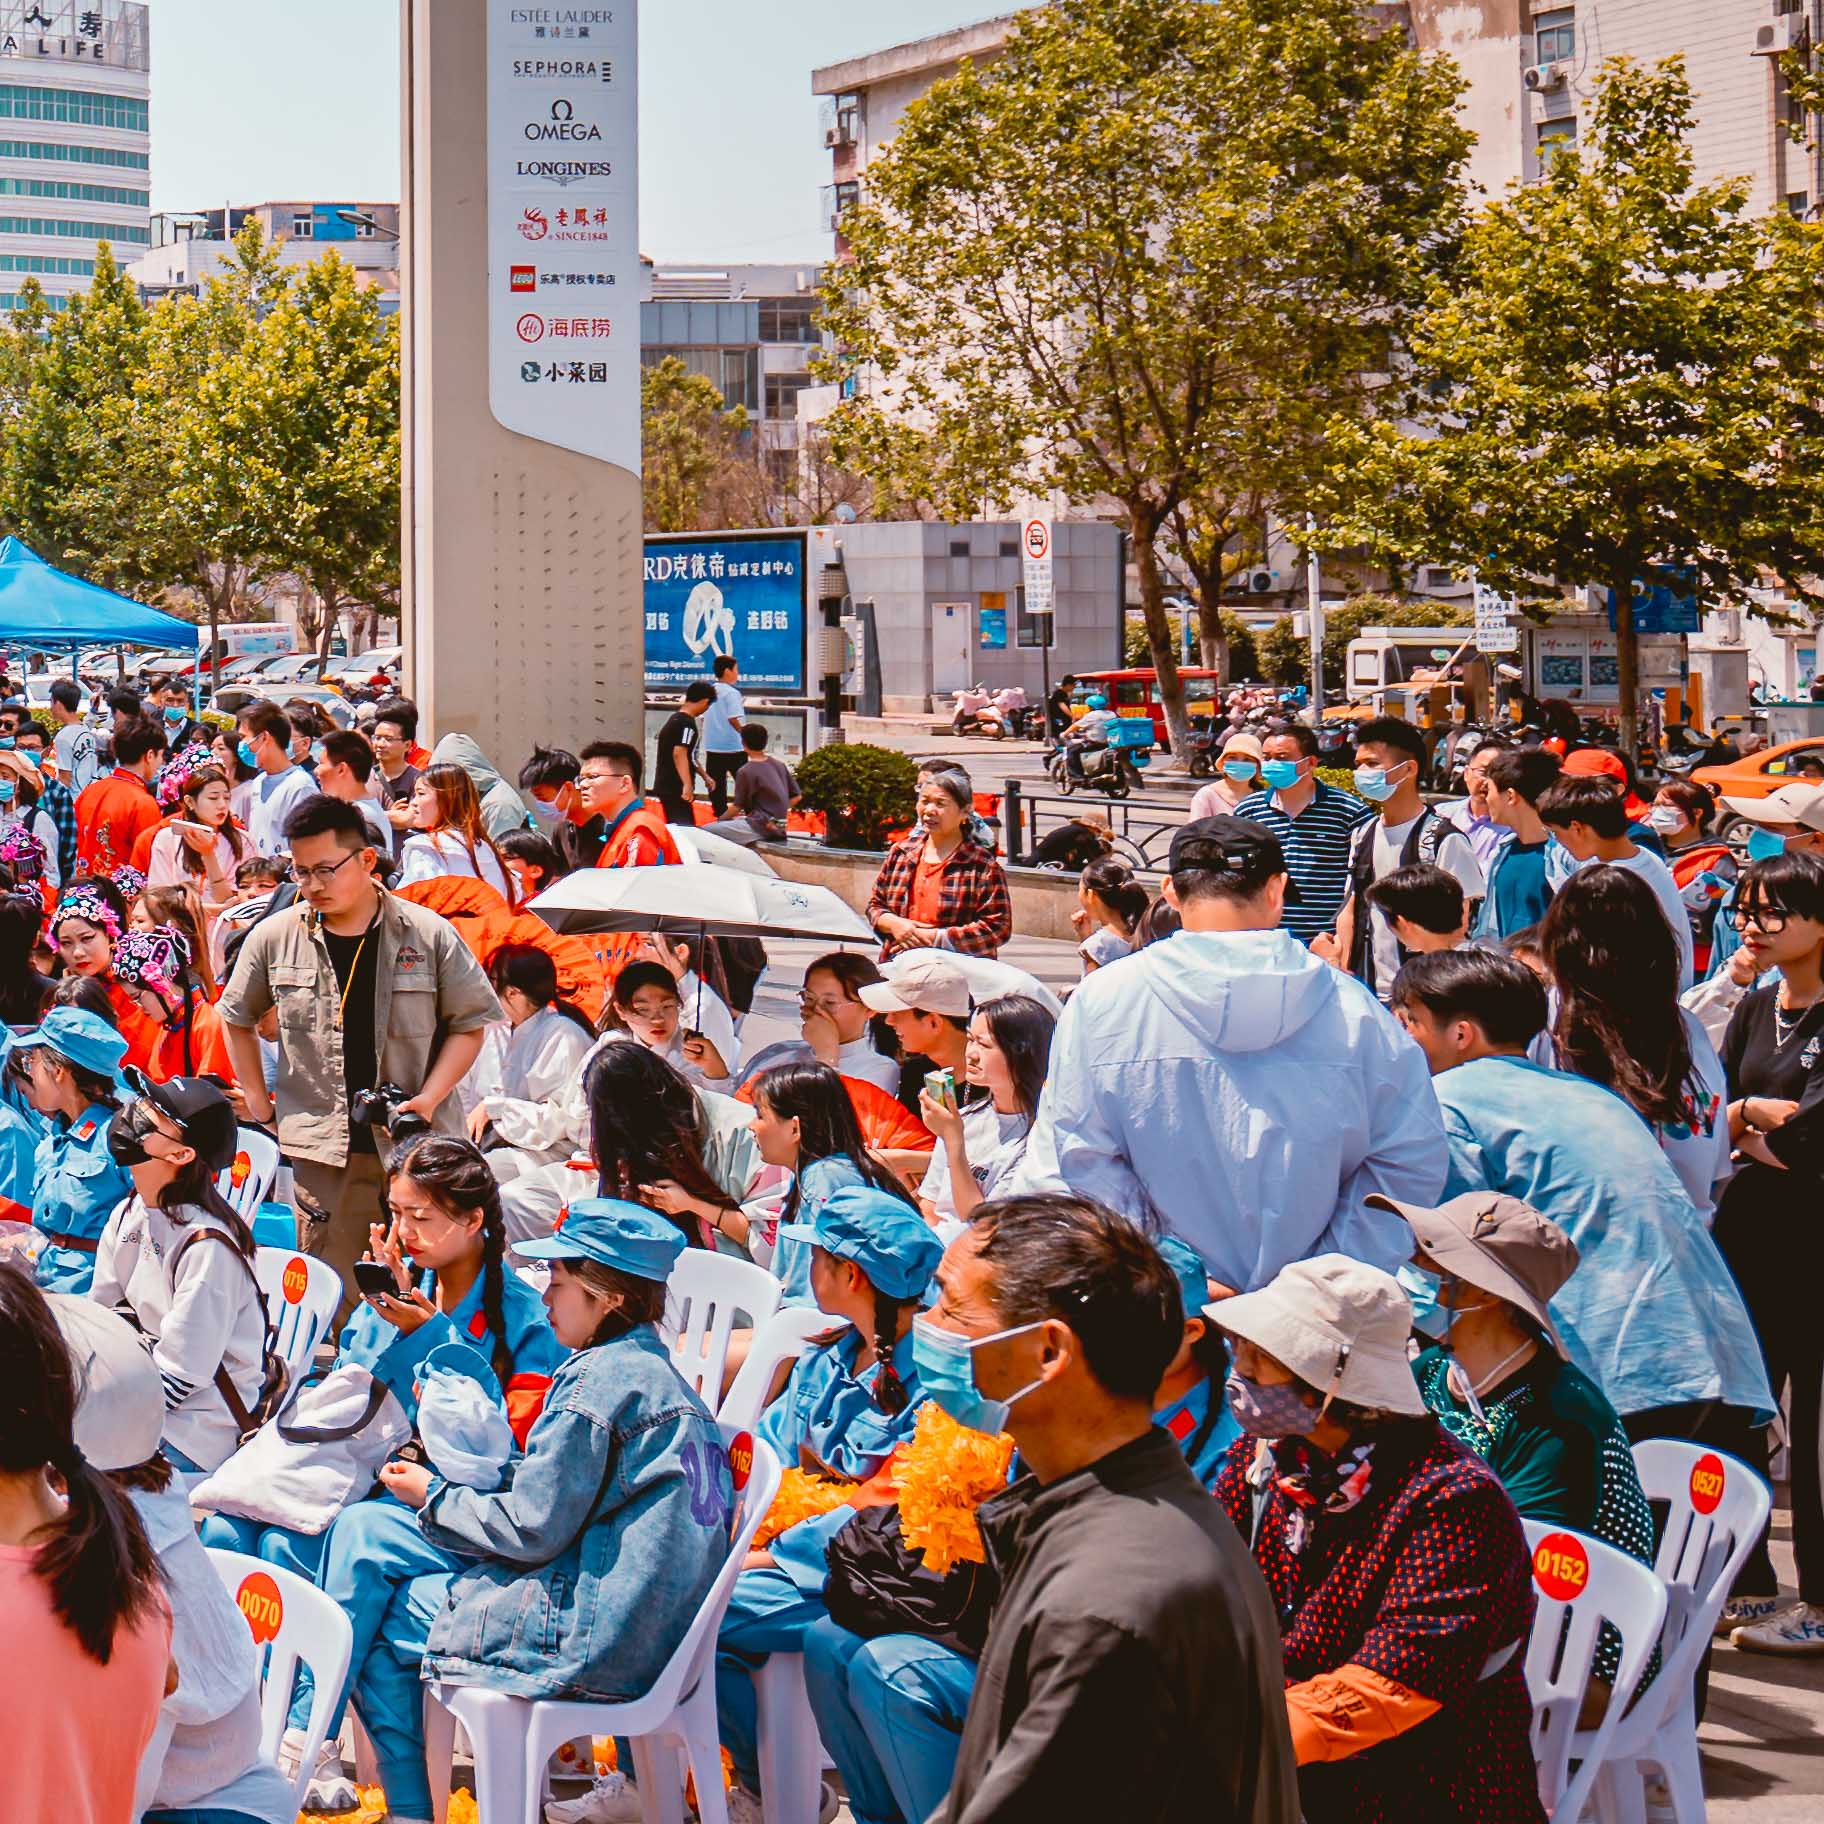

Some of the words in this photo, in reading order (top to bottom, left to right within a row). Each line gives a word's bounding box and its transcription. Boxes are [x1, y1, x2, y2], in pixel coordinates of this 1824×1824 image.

[556, 10, 613, 24] LAUDER
[38, 39, 104, 58] LIFE
[513, 60, 597, 75] SEPHORA
[524, 123, 602, 141] OMEGA
[517, 161, 611, 176] LONGINES
[548, 318, 611, 338] 海底捞
[545, 361, 608, 383] 小菜园
[283, 1269, 307, 1292] 0715
[1692, 1469, 1723, 1499] 0527
[1536, 1548, 1586, 1587] 0152
[240, 1588, 280, 1629] 0070
